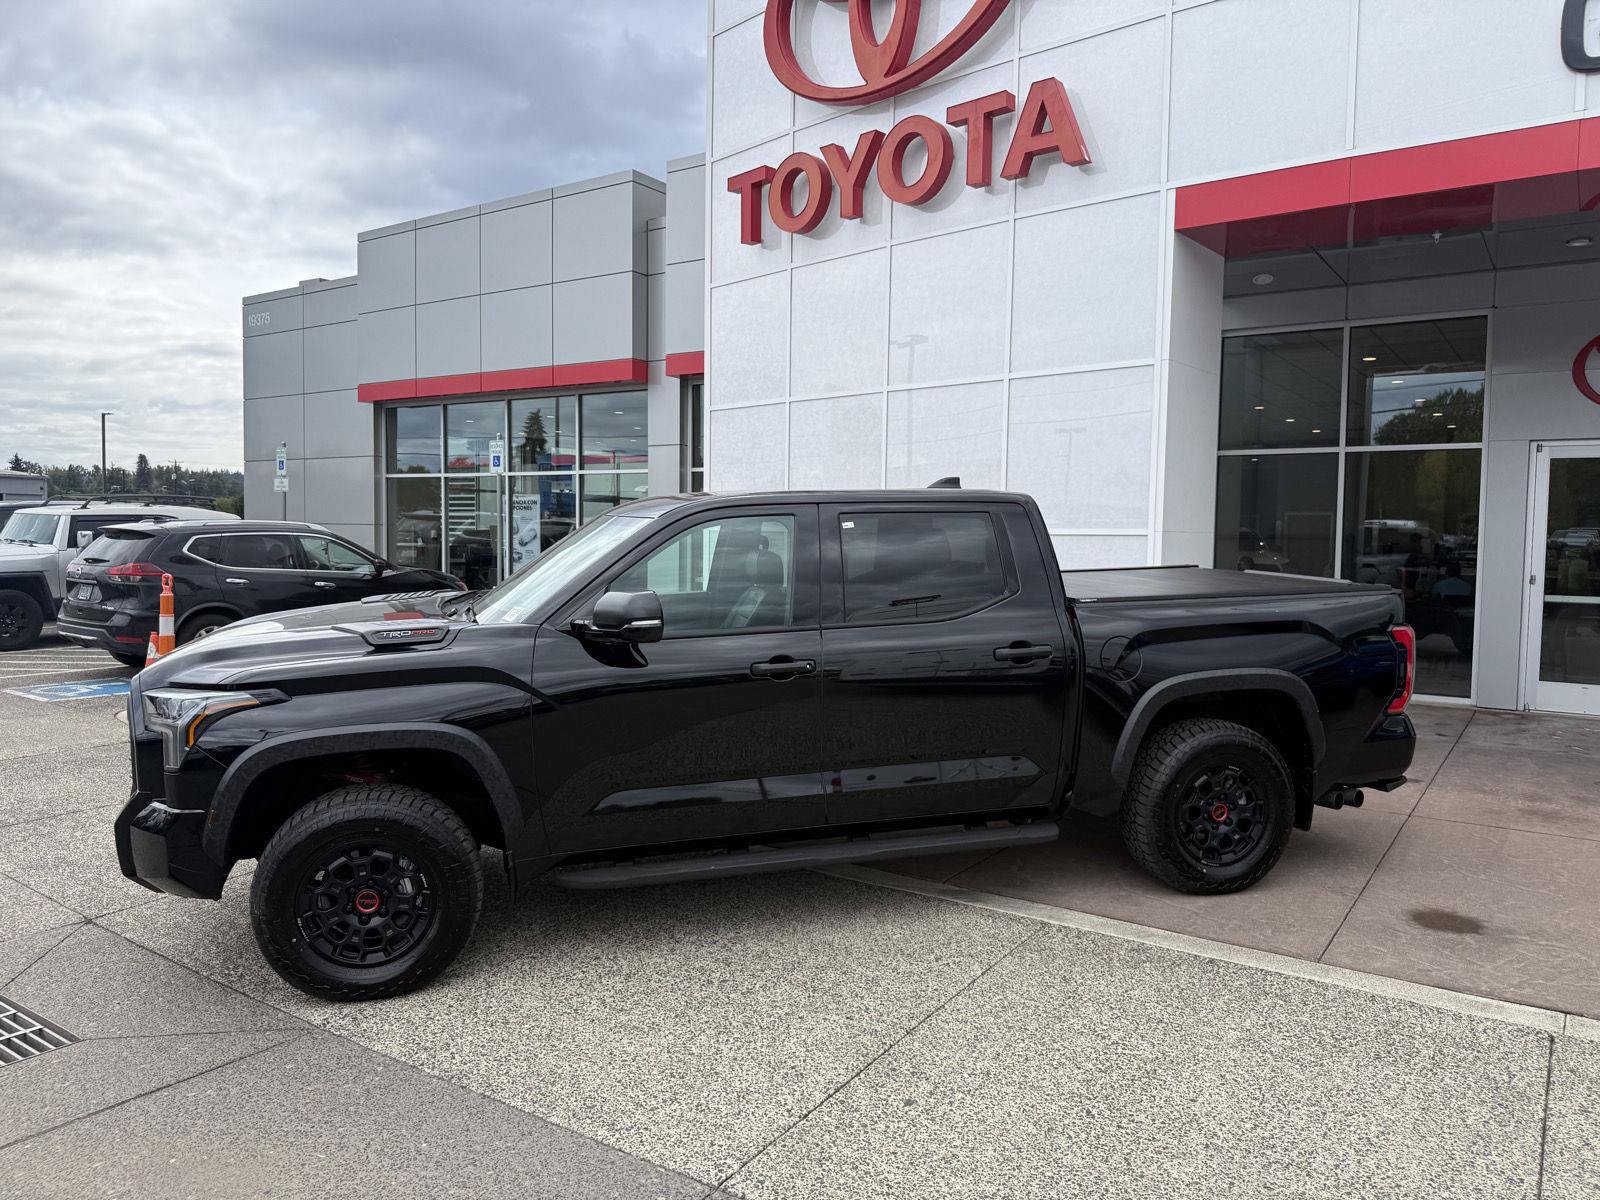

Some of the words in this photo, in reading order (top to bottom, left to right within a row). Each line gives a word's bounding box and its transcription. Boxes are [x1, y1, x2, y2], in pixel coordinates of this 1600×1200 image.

[727, 77, 1091, 245] TOYOTA
[248, 313, 270, 326] 19375
[382, 630, 411, 638] TRD
